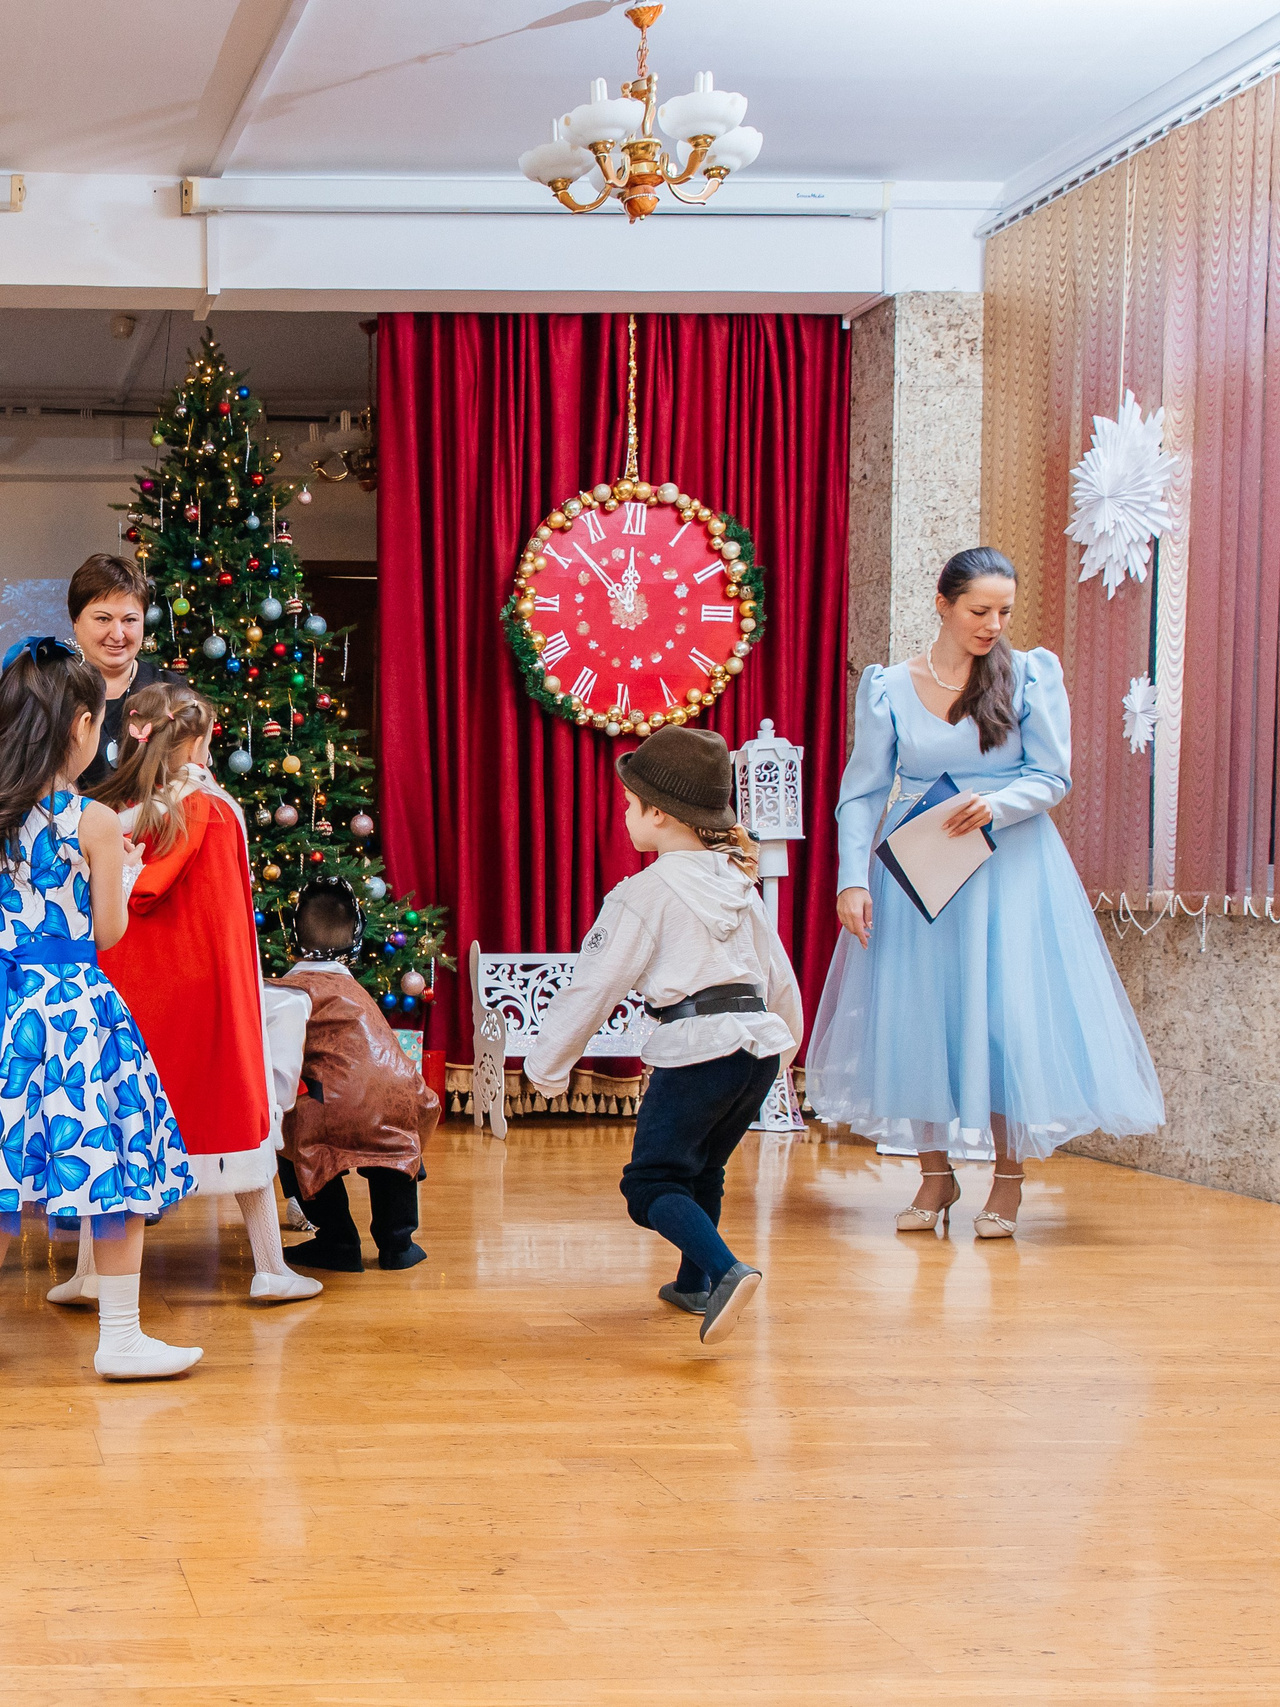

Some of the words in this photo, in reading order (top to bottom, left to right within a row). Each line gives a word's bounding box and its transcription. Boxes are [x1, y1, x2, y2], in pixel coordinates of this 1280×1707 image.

[579, 509, 607, 545] XI
[621, 502, 647, 536] XII
[542, 542, 573, 570] X
[693, 559, 725, 584] II
[533, 594, 560, 613] IX
[701, 604, 734, 622] III
[569, 665, 598, 704] VII
[659, 676, 679, 708] V
